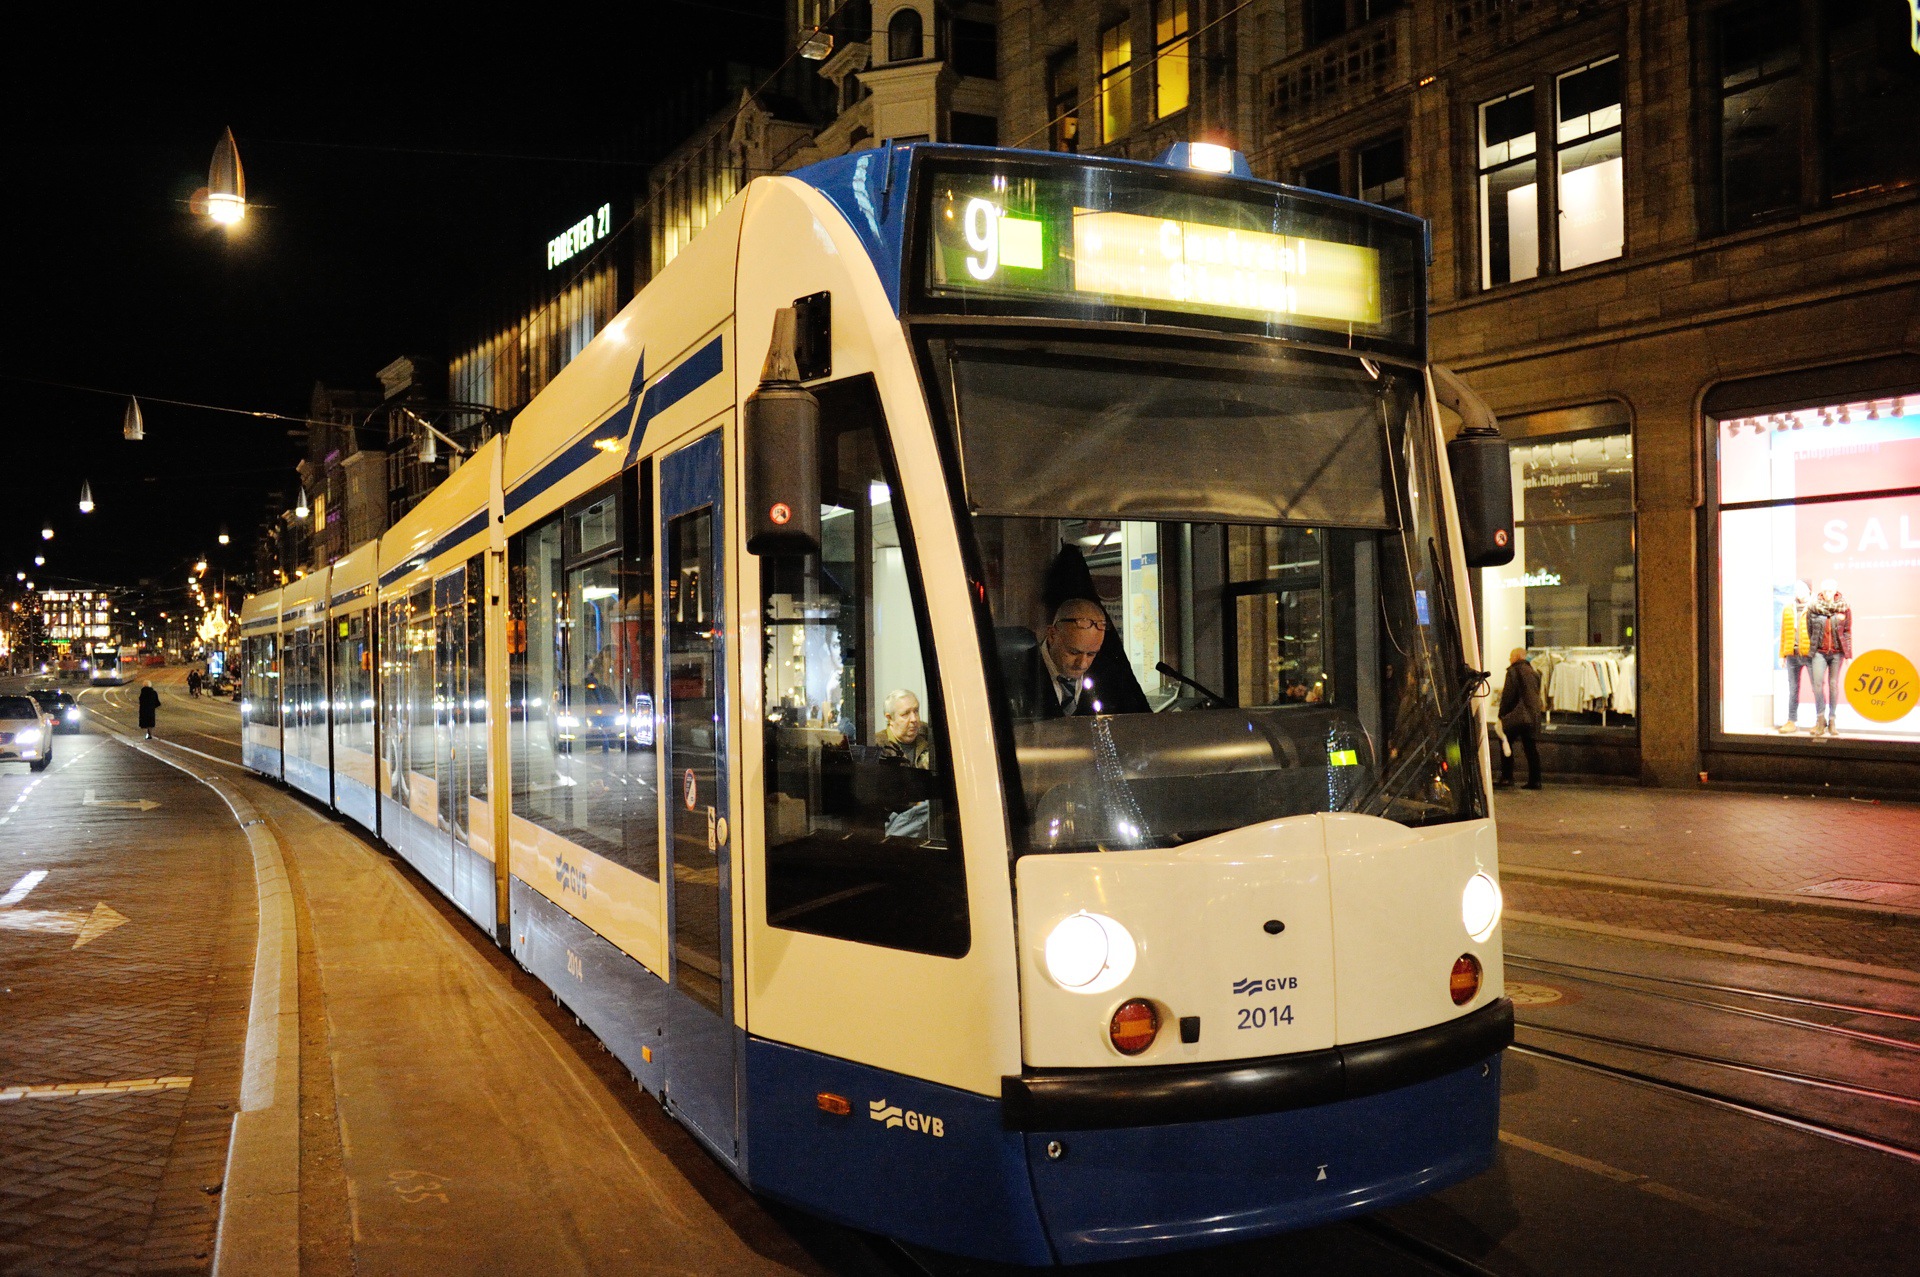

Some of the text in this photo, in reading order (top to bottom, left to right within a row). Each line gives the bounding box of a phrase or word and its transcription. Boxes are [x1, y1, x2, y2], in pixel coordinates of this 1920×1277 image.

[547, 202, 610, 270] FOREVER 21
[965, 198, 998, 280] 9
[1885, 667, 1896, 675] TO
[1870, 698, 1886, 707] OFF
[570, 866, 587, 900] GVB
[567, 949, 583, 982] 2014
[1265, 977, 1298, 991] GVB
[1237, 1004, 1294, 1030] 2014
[904, 1109, 945, 1138] GVB
